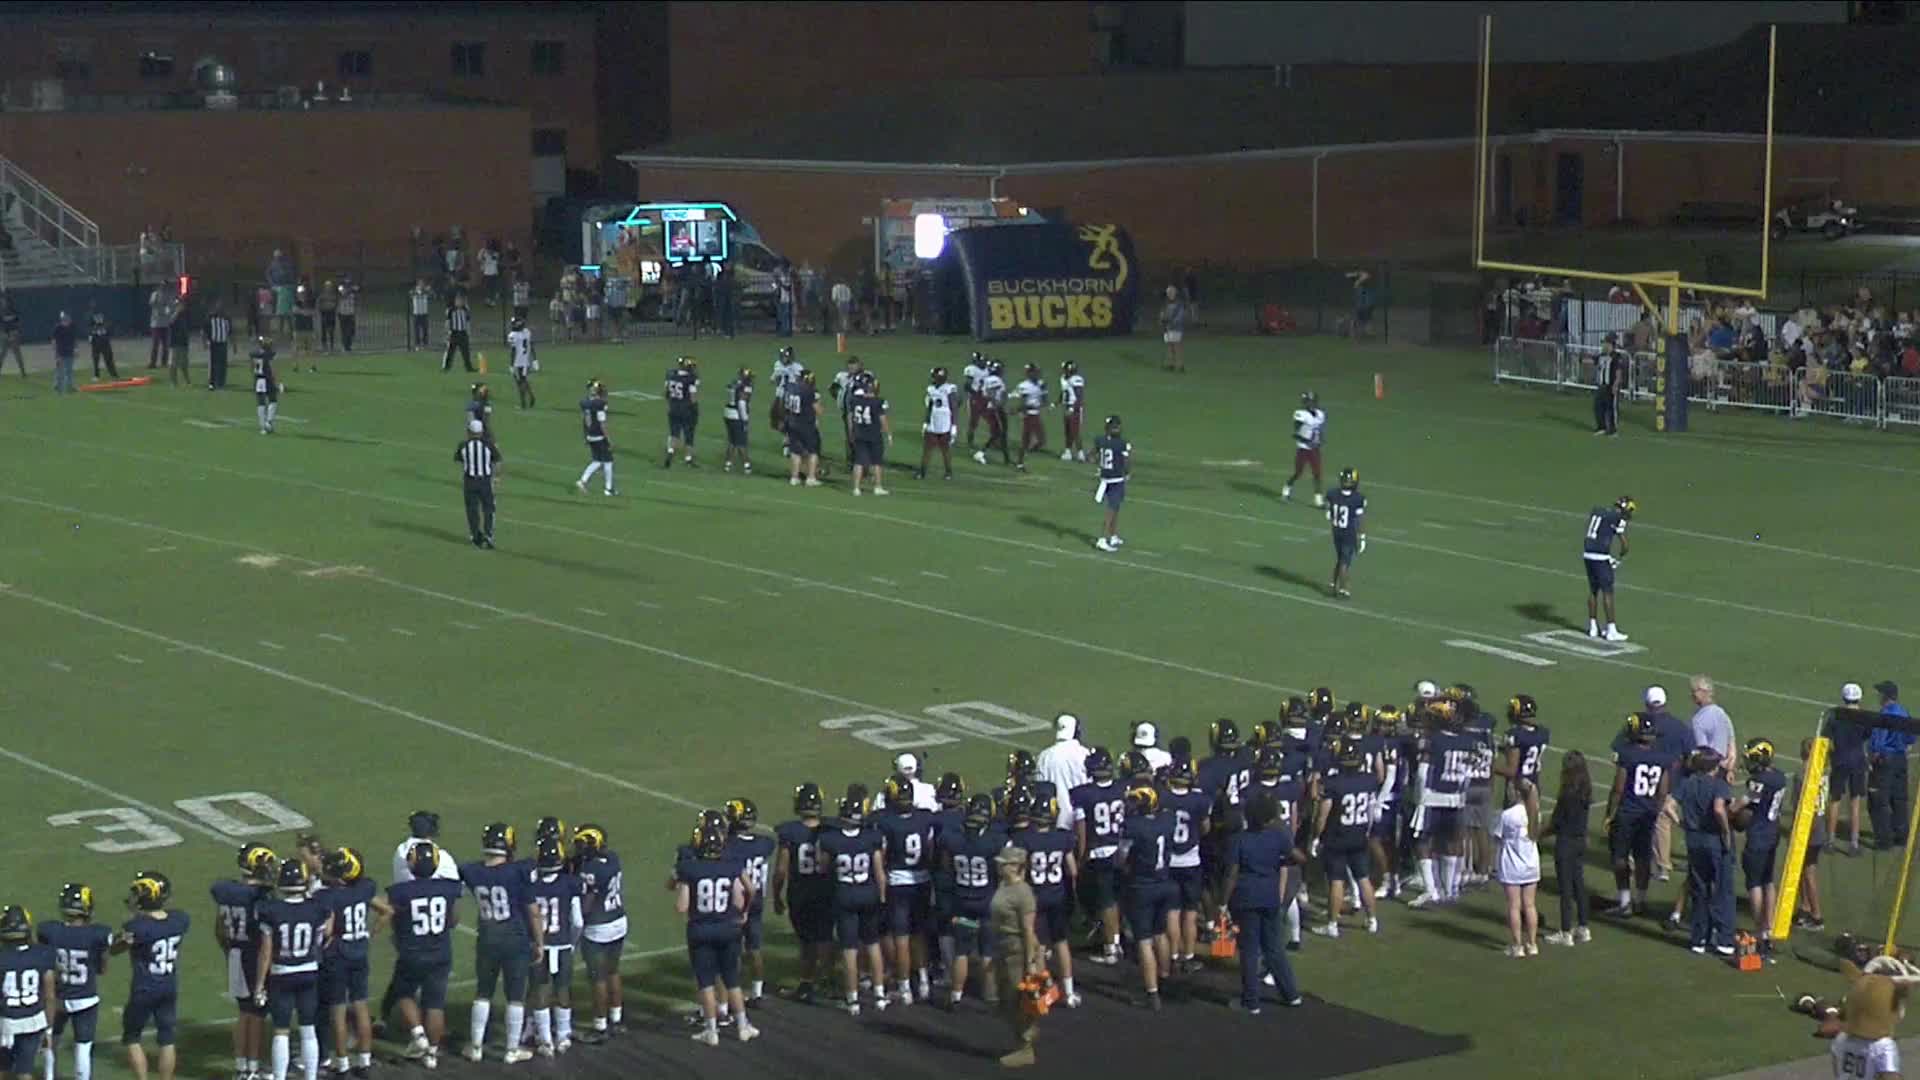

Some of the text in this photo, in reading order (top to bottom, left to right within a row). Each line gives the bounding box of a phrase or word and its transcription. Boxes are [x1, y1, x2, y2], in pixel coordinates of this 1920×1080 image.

[988, 278, 1113, 294] BUCKHORN
[989, 295, 1113, 329] BUCKS
[1100, 448, 1113, 469] 12
[1333, 504, 1349, 528] 13
[1440, 629, 1649, 666] 10
[819, 701, 1053, 750] 20
[47, 791, 312, 854] 30
[1341, 793, 1368, 825] 32
[1173, 810, 1191, 844] 6
[904, 833, 921, 865] 9
[837, 853, 870, 882] 29
[697, 877, 731, 912] 86
[342, 902, 370, 941] 18
[410, 896, 447, 935] 58
[279, 922, 312, 957] 10
